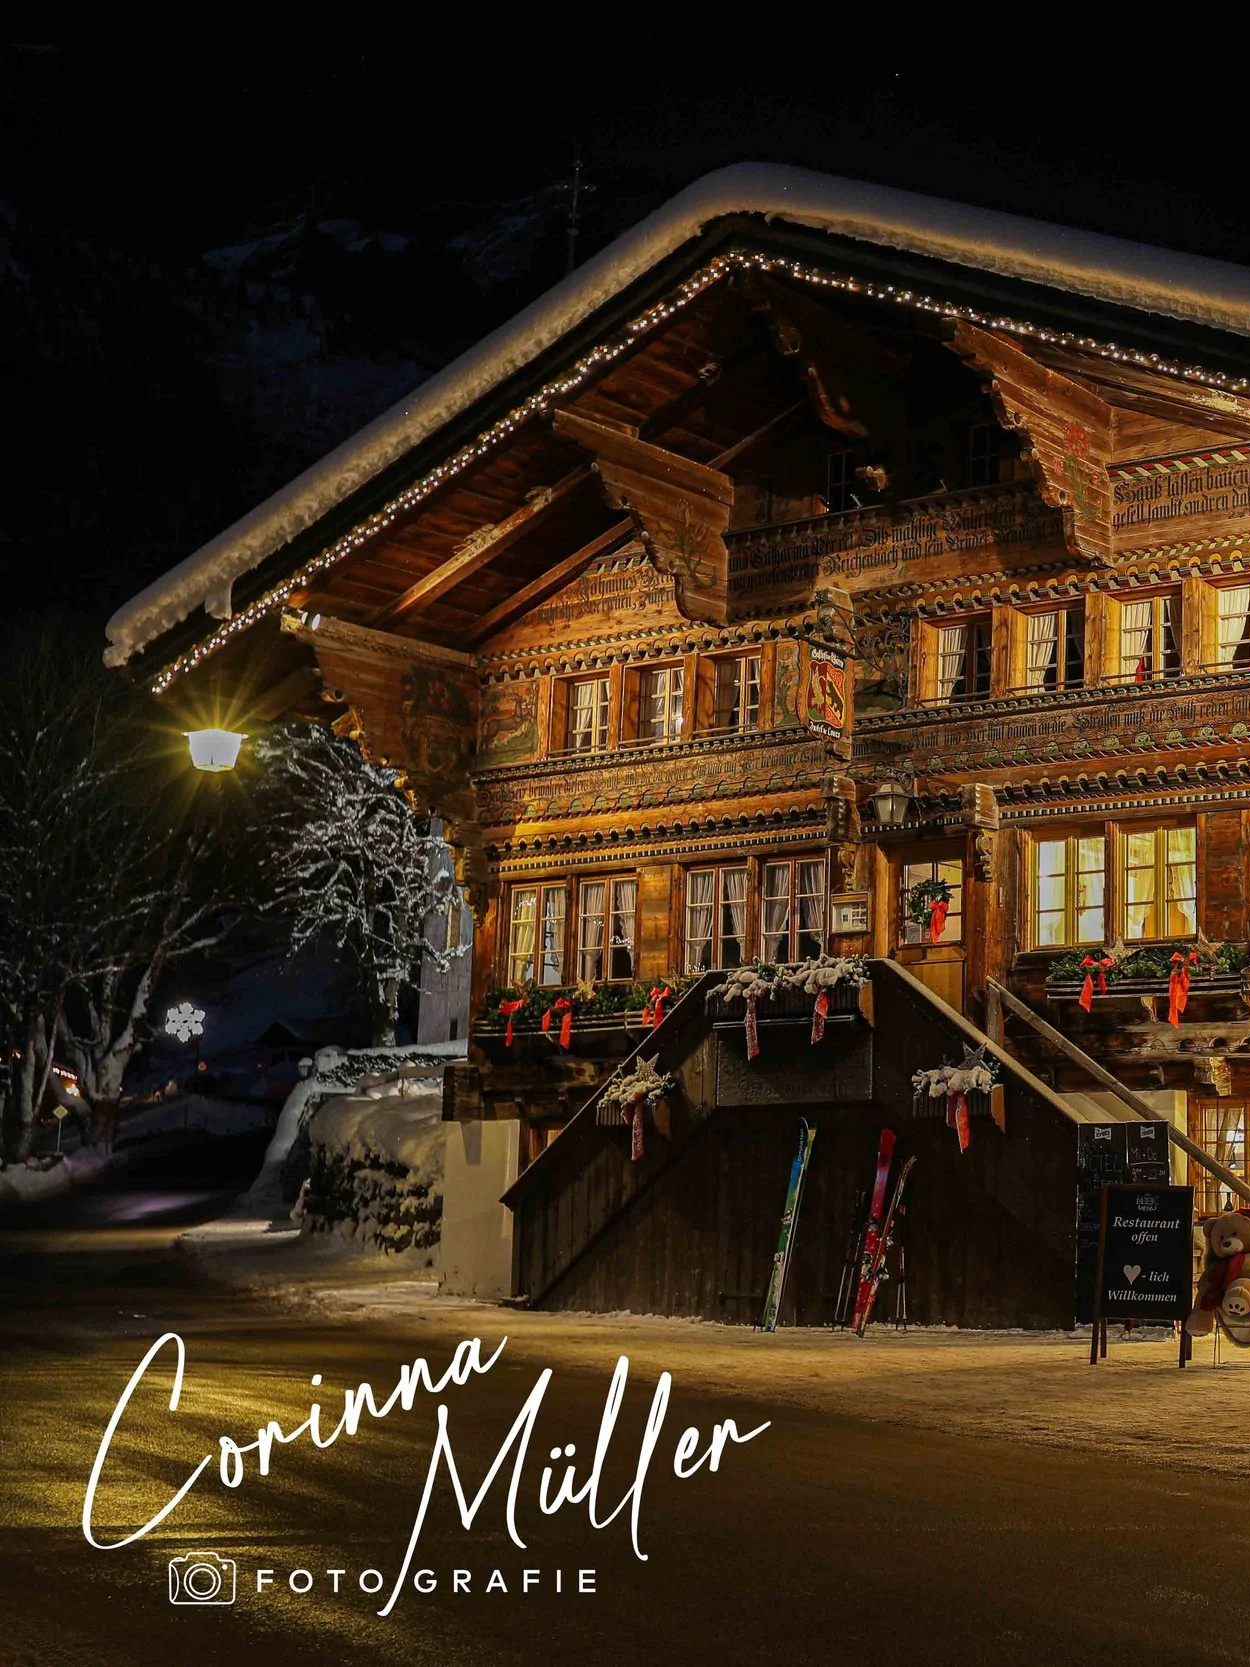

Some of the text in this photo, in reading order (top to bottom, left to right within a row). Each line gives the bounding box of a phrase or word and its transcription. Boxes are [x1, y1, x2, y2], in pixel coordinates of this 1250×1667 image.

[1113, 1216, 1181, 1229] Restaurant
[1131, 1231, 1159, 1245] offen
[1107, 1289, 1178, 1302] Willkommen
